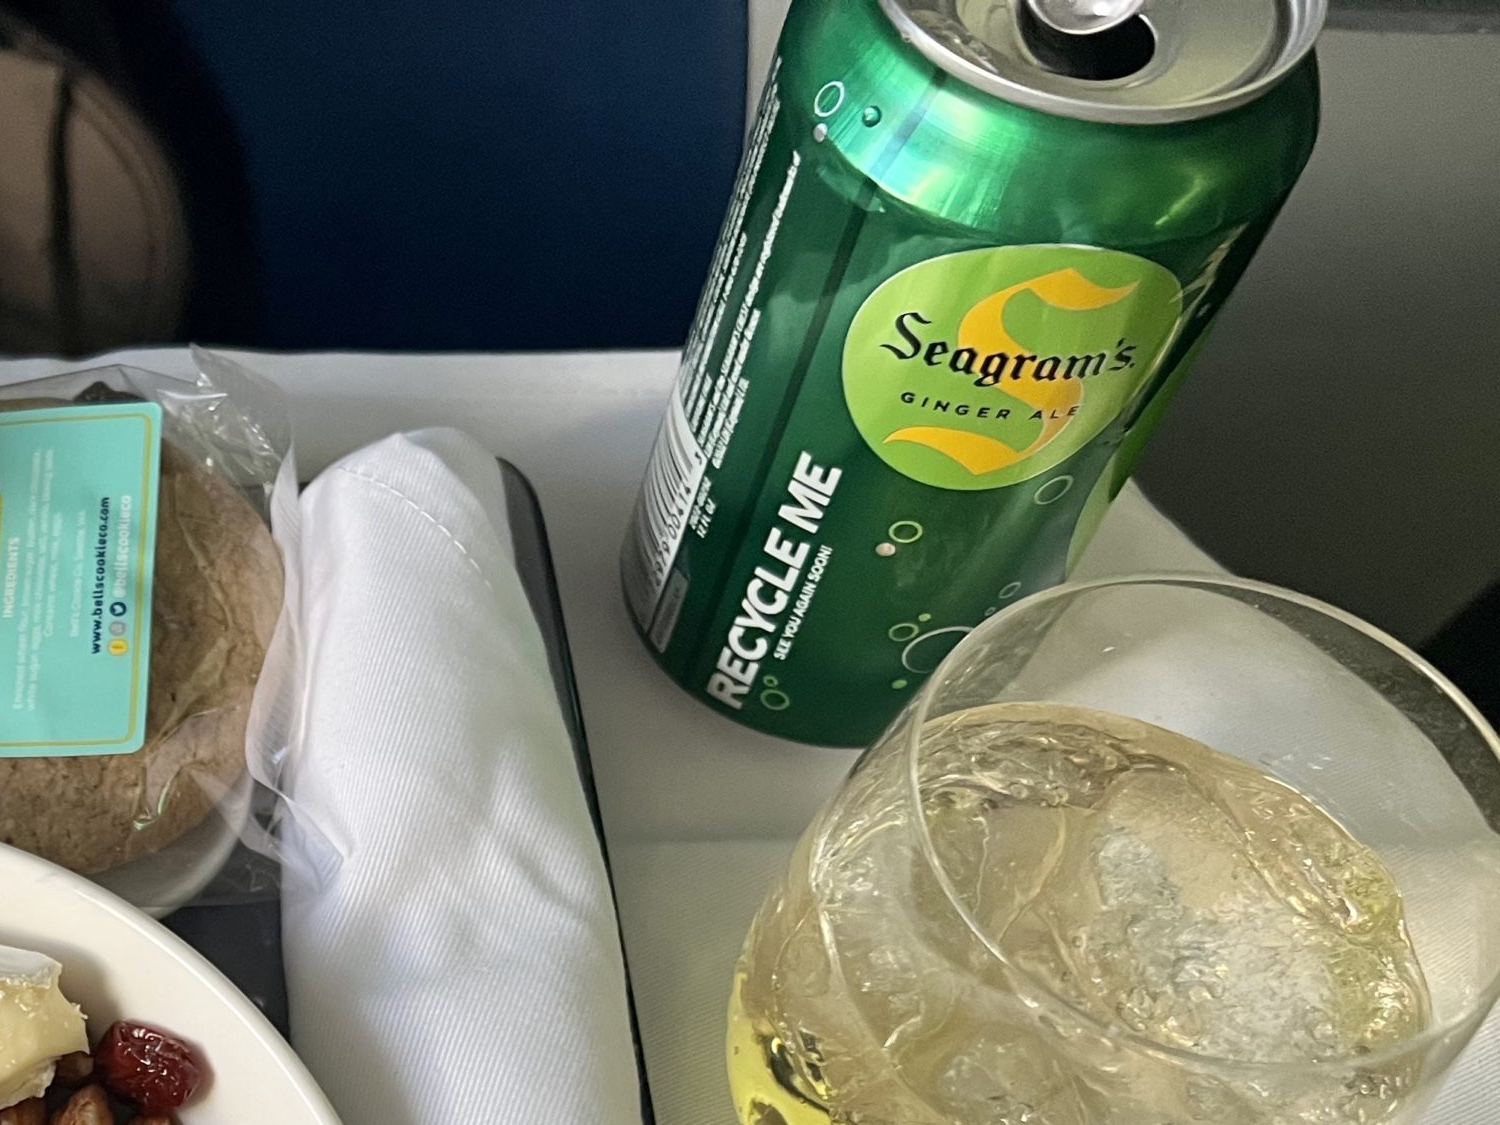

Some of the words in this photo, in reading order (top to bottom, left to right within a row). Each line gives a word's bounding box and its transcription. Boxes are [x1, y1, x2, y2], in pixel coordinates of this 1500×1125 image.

[879, 311, 1138, 387] Seagram's
[899, 391, 1012, 421] GINGER
[1028, 405, 1081, 421] ALE
[3, 537, 20, 618] INGREDIENTS
[89, 496, 112, 654] www.bellscookieco.com
[707, 526, 808, 710] RECYCLE
[776, 451, 843, 533] ME
[772, 637, 792, 661] SEE
[782, 614, 802, 640] YOU
[792, 580, 817, 617] AGAIN
[806, 543, 832, 583] SOON!
